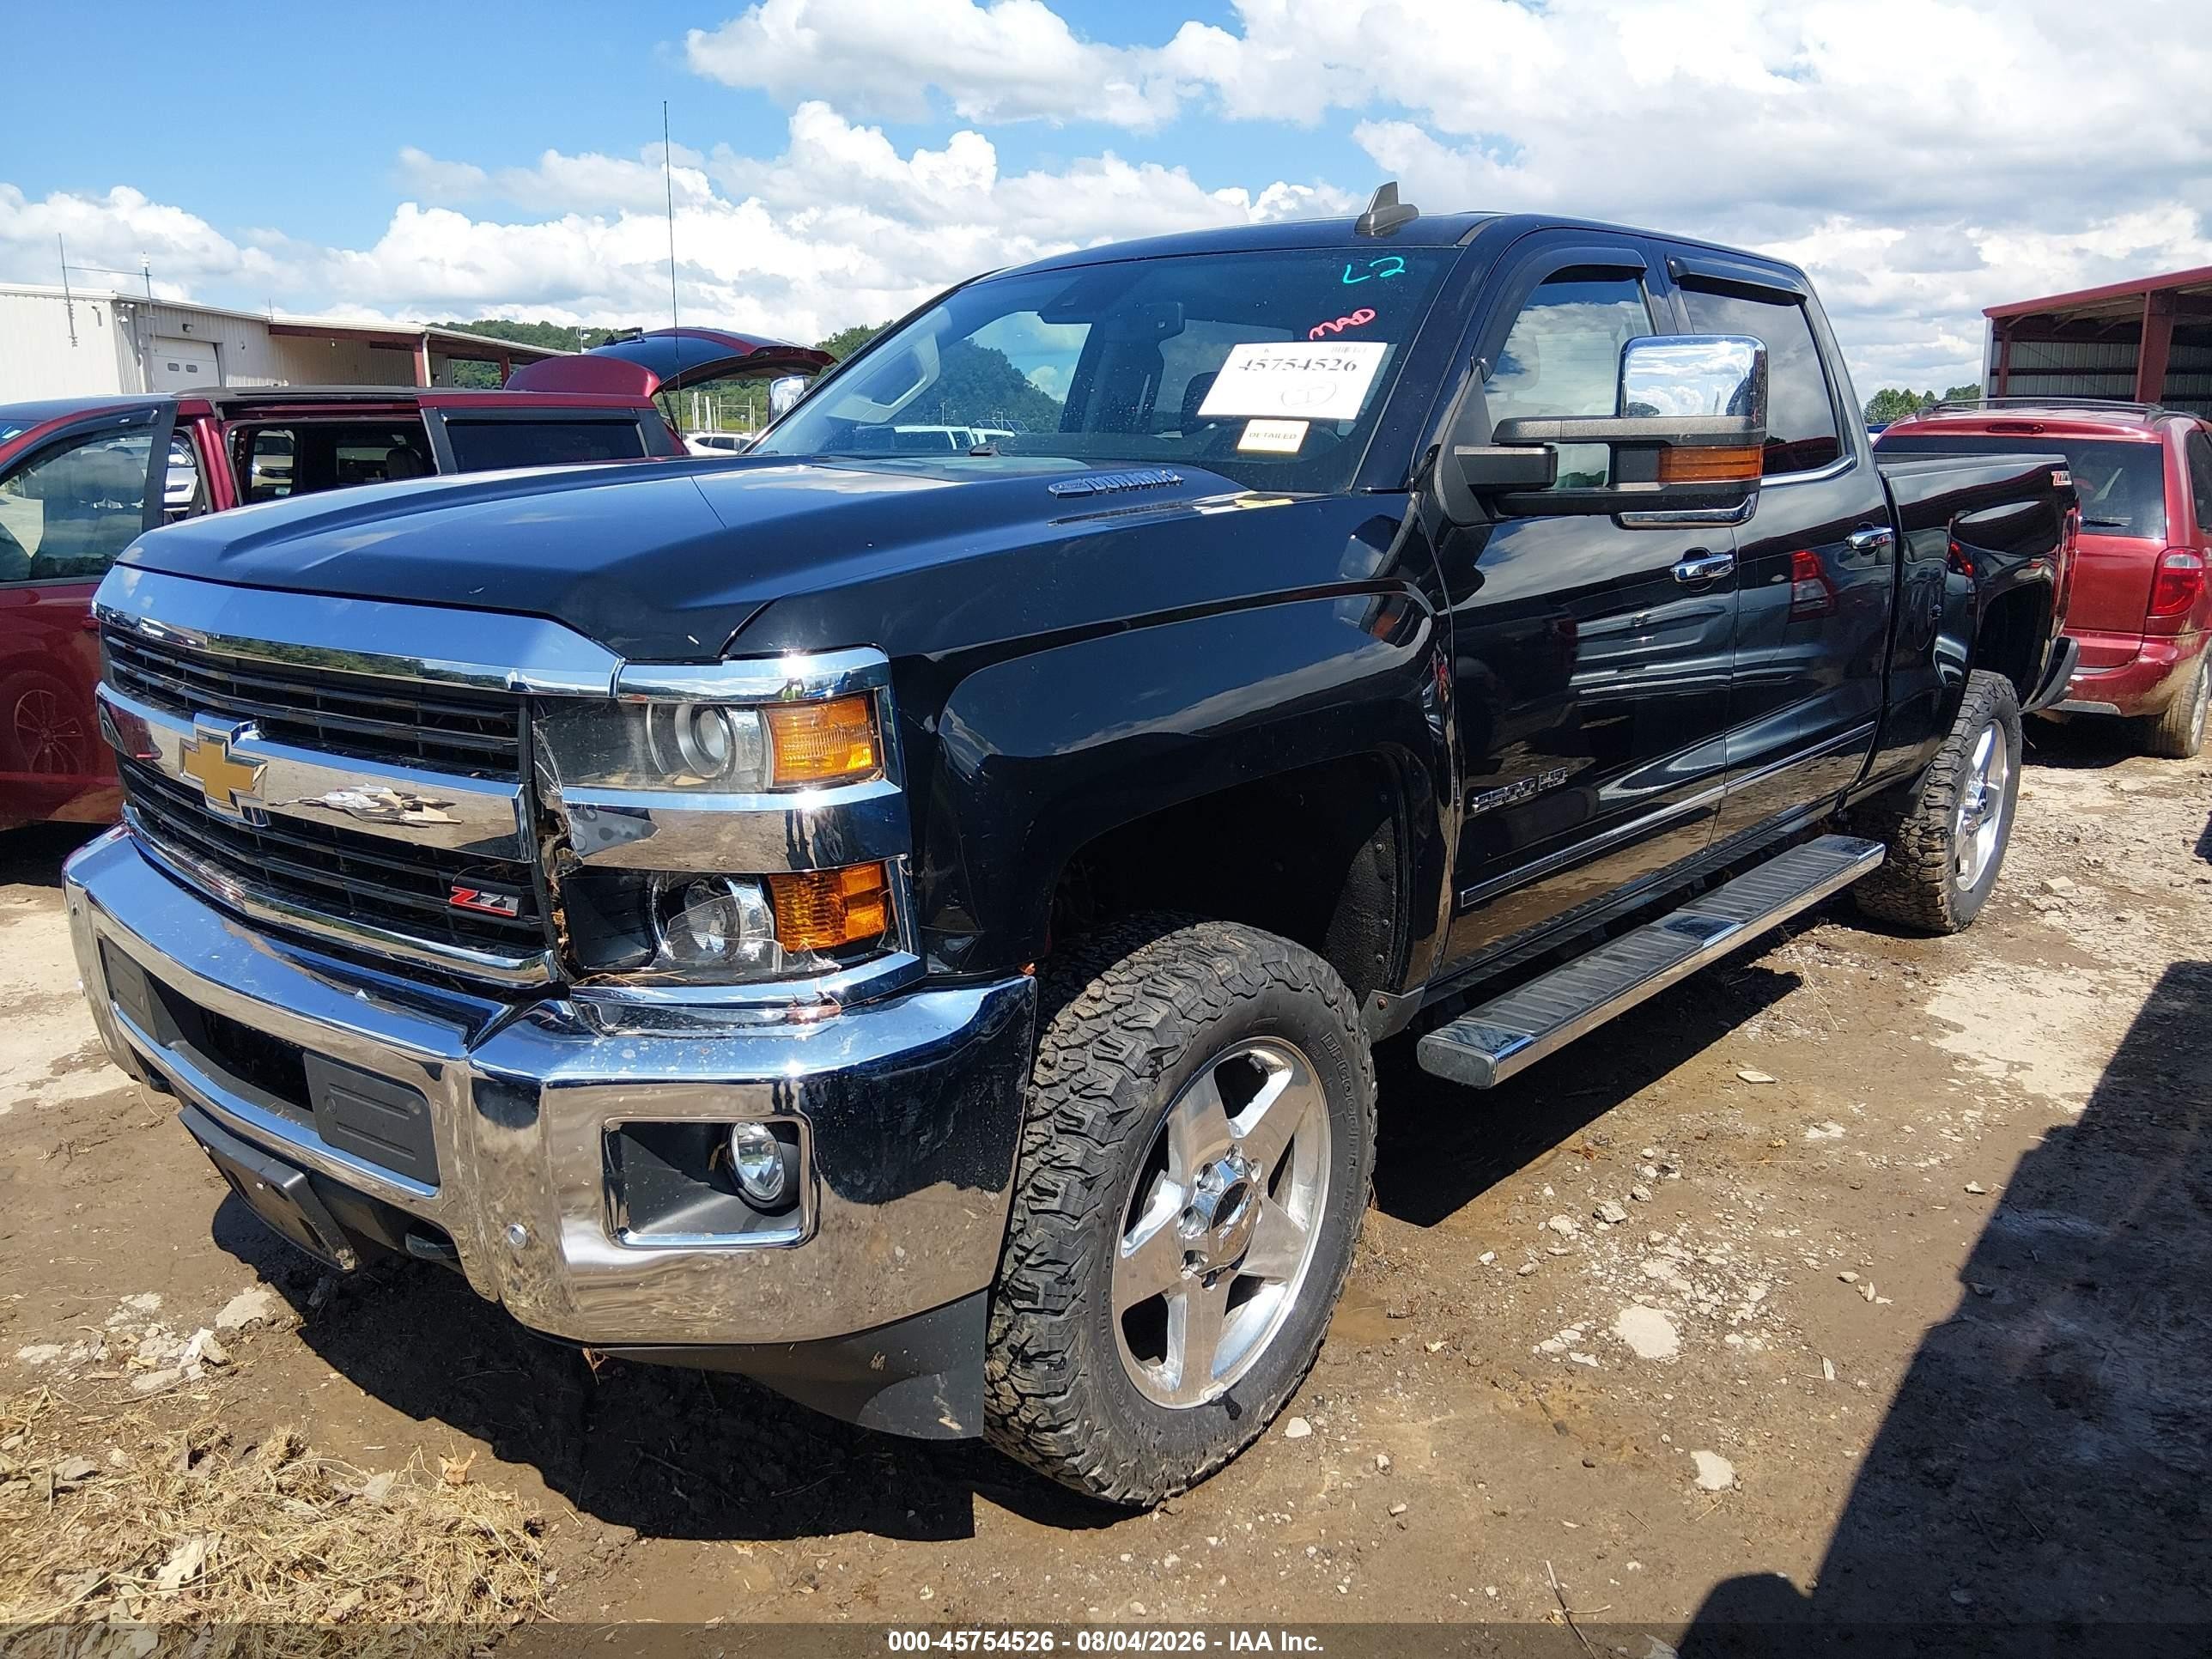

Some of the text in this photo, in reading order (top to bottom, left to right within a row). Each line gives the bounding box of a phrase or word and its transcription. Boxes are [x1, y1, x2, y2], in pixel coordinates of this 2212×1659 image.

[1342, 256, 1406, 284] L2
[1238, 357, 1358, 373] 45754526
[1249, 431, 1297, 441] DETAILED
[449, 885, 520, 917] Z71
